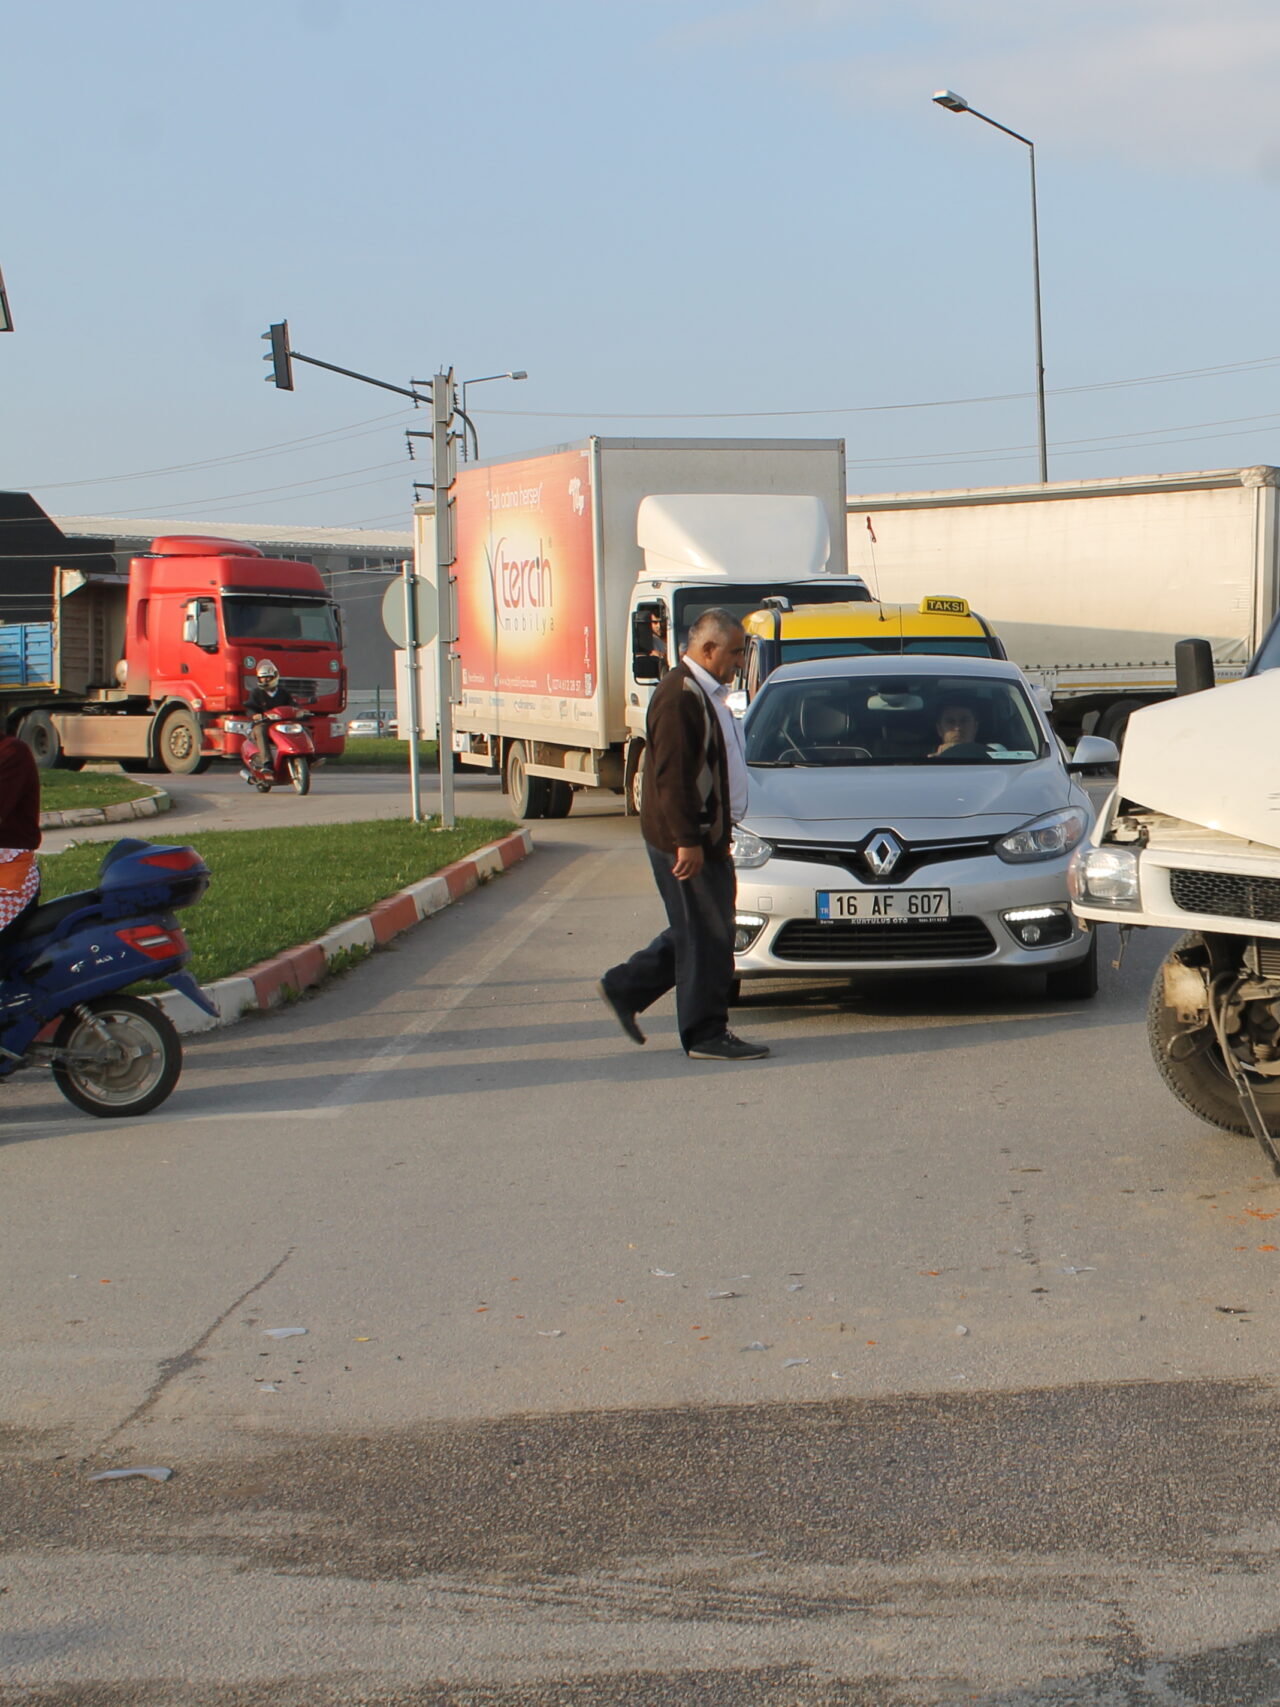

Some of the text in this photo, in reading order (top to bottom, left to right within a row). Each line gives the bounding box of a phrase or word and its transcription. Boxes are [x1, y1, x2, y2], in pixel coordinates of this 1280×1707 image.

[500, 538, 553, 608] tercih
[504, 613, 555, 635] mobilya
[836, 894, 943, 916] 16 AF 607
